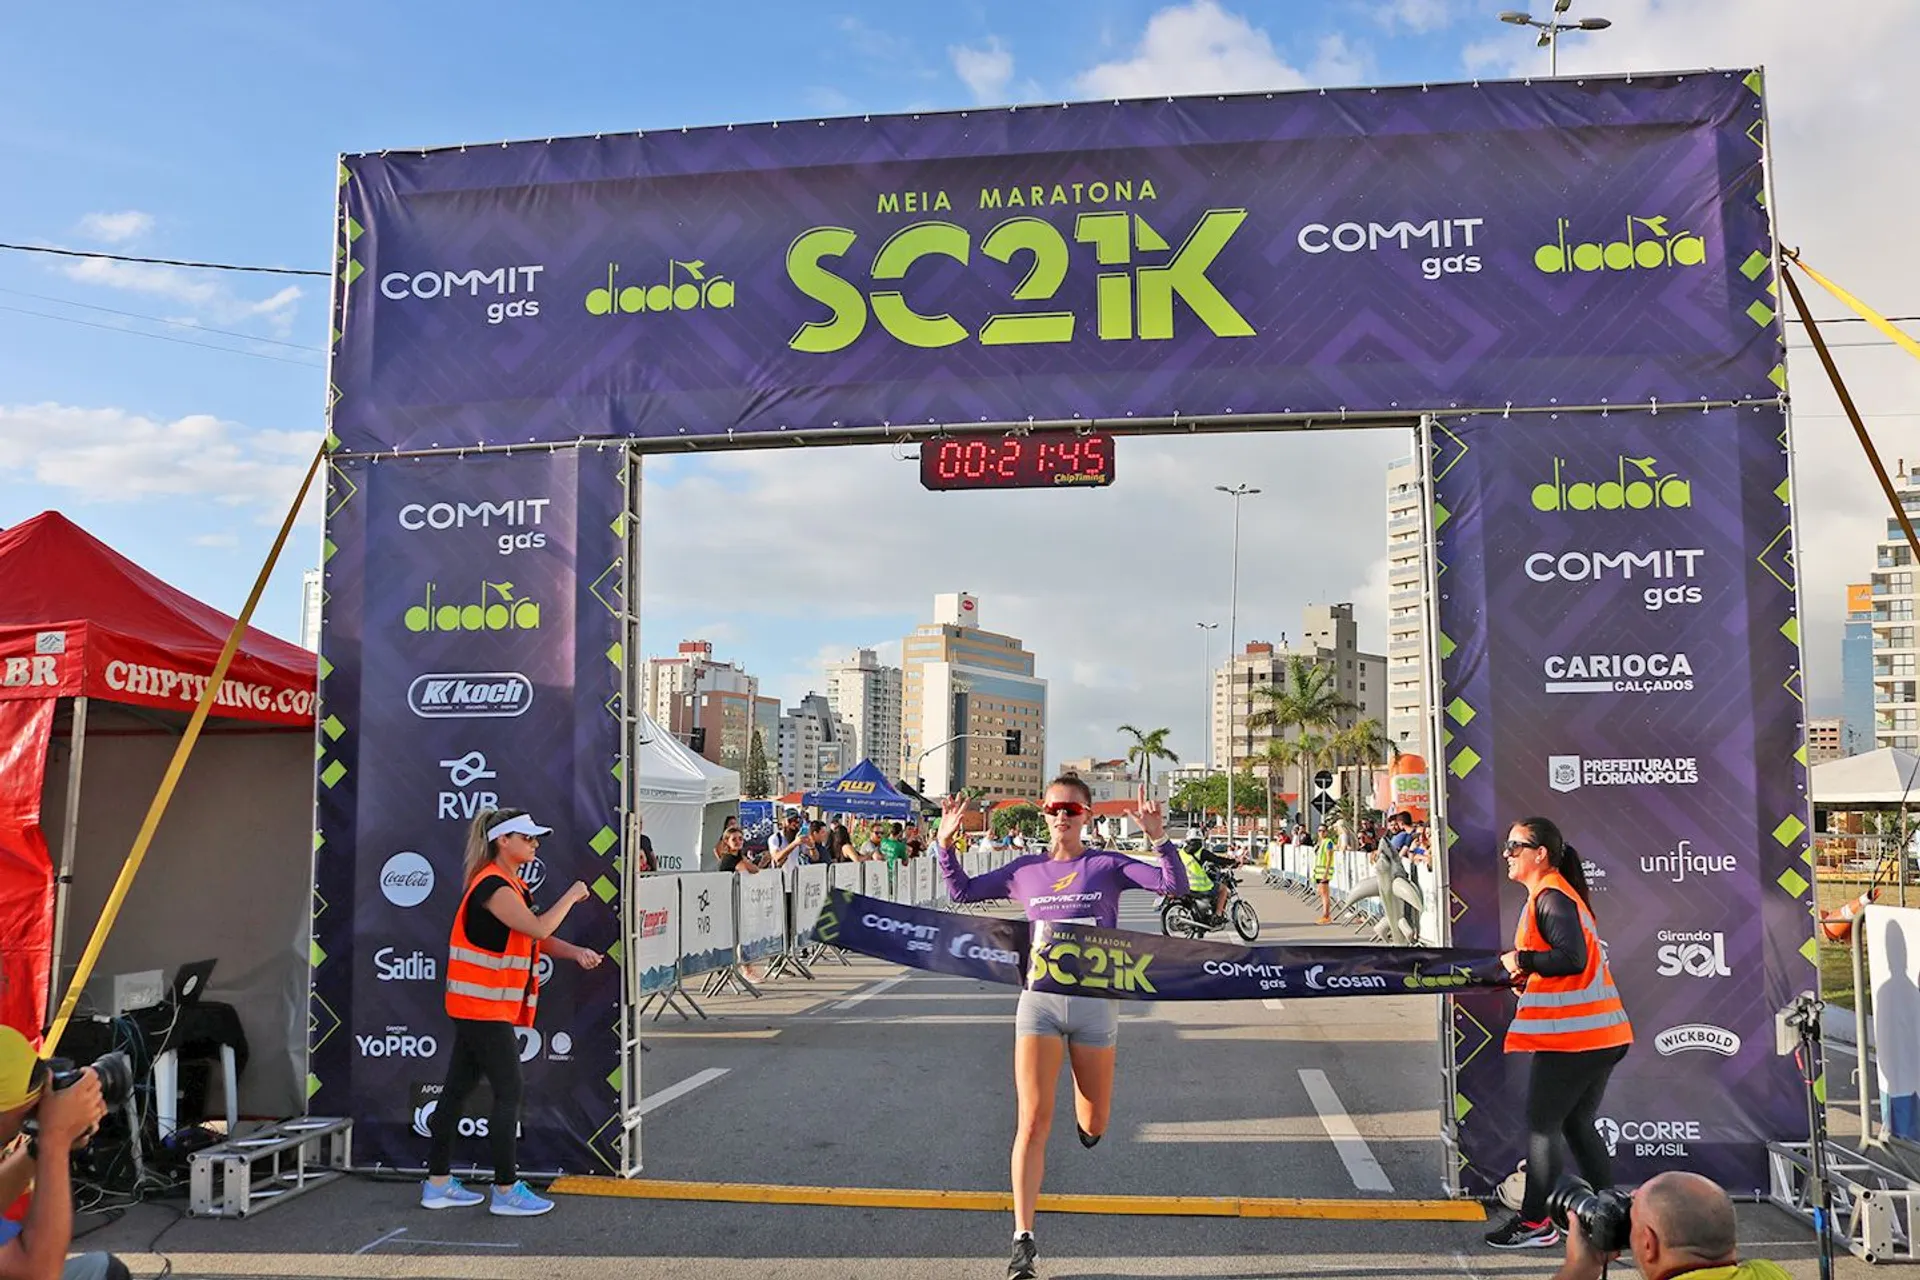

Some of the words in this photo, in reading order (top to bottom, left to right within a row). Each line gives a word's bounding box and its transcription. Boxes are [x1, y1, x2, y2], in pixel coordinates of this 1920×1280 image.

[876, 190, 951, 214] MEIA
[979, 179, 1157, 209] MARATONA
[1297, 217, 1484, 255] COMMIT
[1534, 215, 1706, 274] diadora
[380, 264, 543, 301] COMMIT
[585, 259, 735, 316] diadora
[786, 208, 1257, 353] SC21K
[1053, 472, 1106, 485] ChipTiming
[1531, 455, 1691, 512] diadora
[399, 499, 550, 531] COMMIT
[1524, 549, 1705, 583] COMMIT
[404, 580, 541, 632] diadora
[1545, 653, 1693, 679] CARIOCA
[1614, 679, 1695, 694] CALÇADOS
[1583, 758, 1673, 772] PREFEITURA
[1675, 757, 1697, 771] DE
[438, 791, 499, 820] RVB
[1640, 841, 1737, 882] unifique
[862, 912, 940, 942] COMMIT
[1053, 931, 1077, 942] MEIA
[1084, 935, 1133, 949] MARATONA
[1657, 931, 1711, 943] Girando
[374, 947, 435, 981] Sadia
[968, 945, 1020, 964] cosan
[1202, 959, 1284, 978] COMMIT
[1326, 974, 1387, 989] cosan
[355, 1034, 437, 1058] YoPRO
[1661, 1031, 1733, 1047] WICKBOLD
[421, 1084, 444, 1095] APOI
[1621, 1121, 1701, 1141] CORRE
[1635, 1143, 1688, 1157] BRASIL
